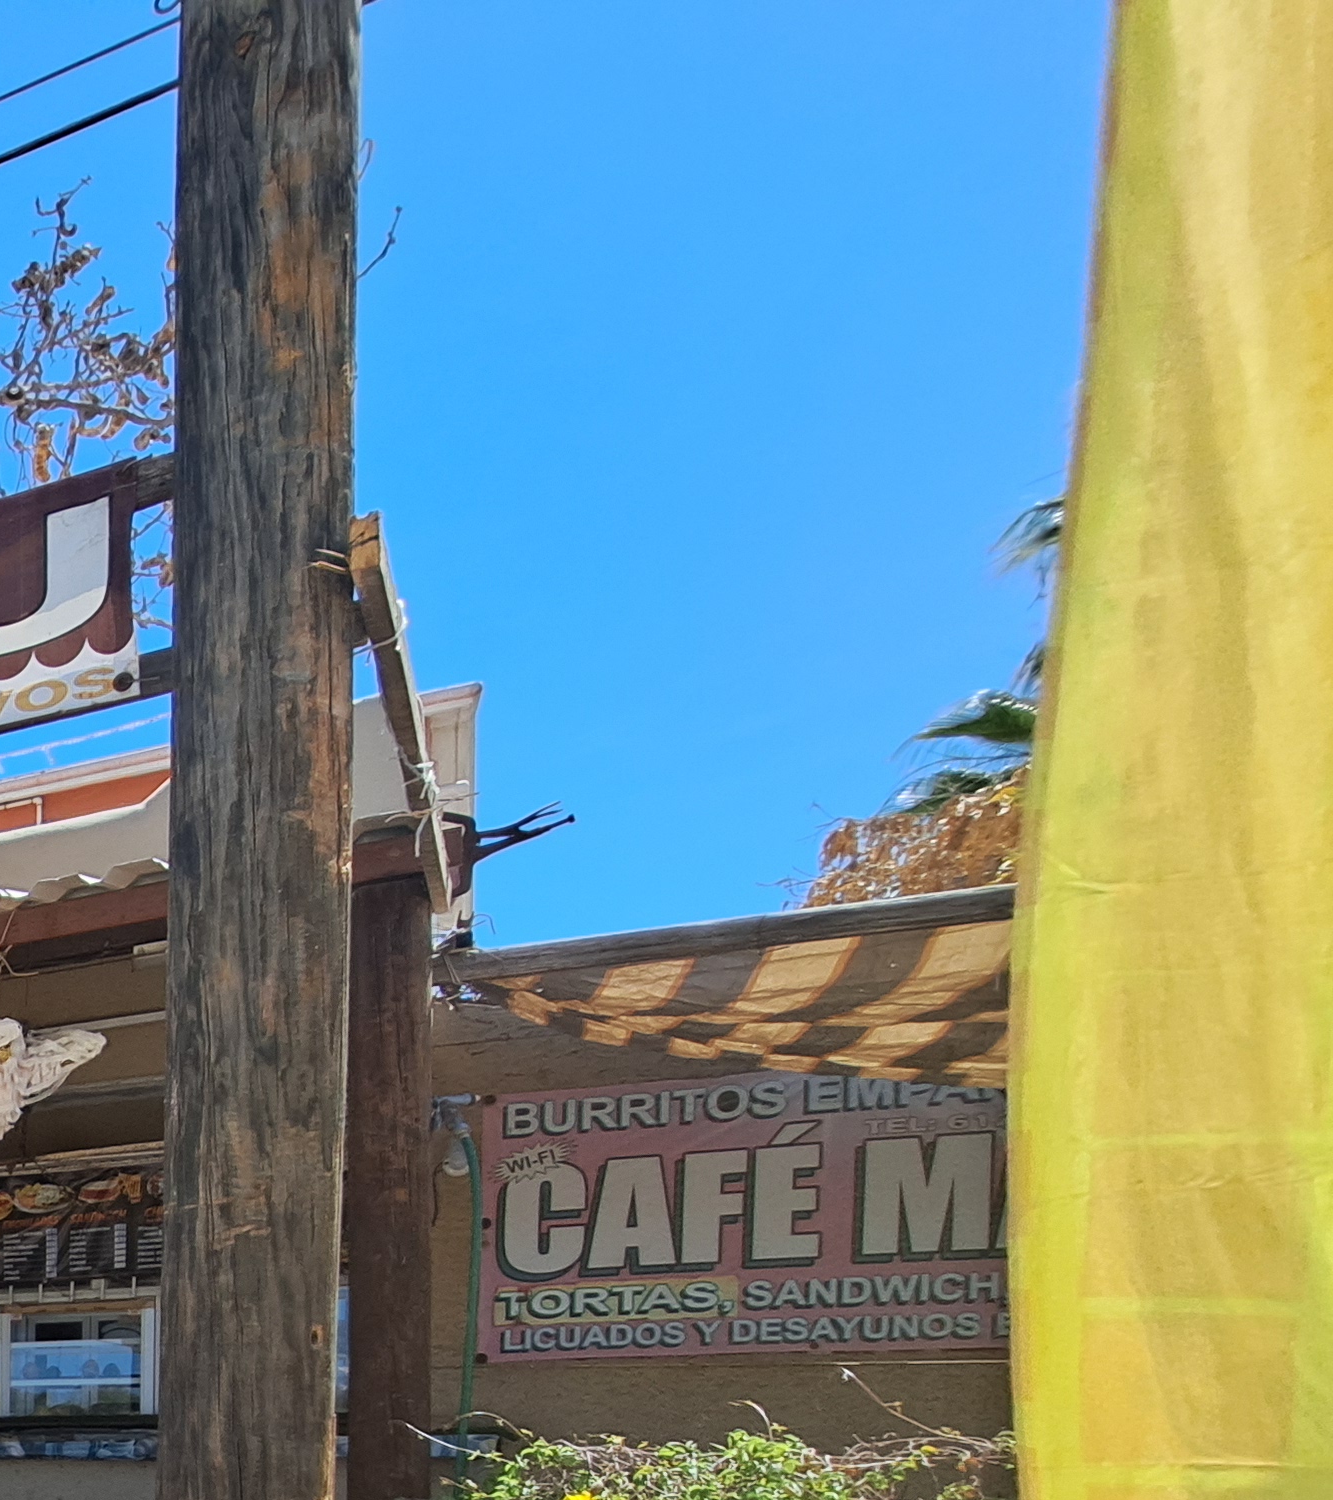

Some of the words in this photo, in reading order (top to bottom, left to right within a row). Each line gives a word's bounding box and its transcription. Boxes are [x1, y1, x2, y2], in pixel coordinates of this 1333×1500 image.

[504, 1080, 788, 1138] BURRITOS
[865, 1117, 936, 1136] TEL:
[948, 1113, 1005, 1131] 61
[504, 1148, 557, 1174] WI-FI
[496, 1120, 822, 1281] CAFÉ
[853, 1131, 1007, 1263] M
[496, 1281, 734, 1321] TORTAS,
[744, 1271, 1008, 1309] SANDWICH
[501, 1322, 686, 1353] LICUADOS
[696, 1320, 720, 1346] Y
[733, 1313, 982, 1345] DESAYUNOS
